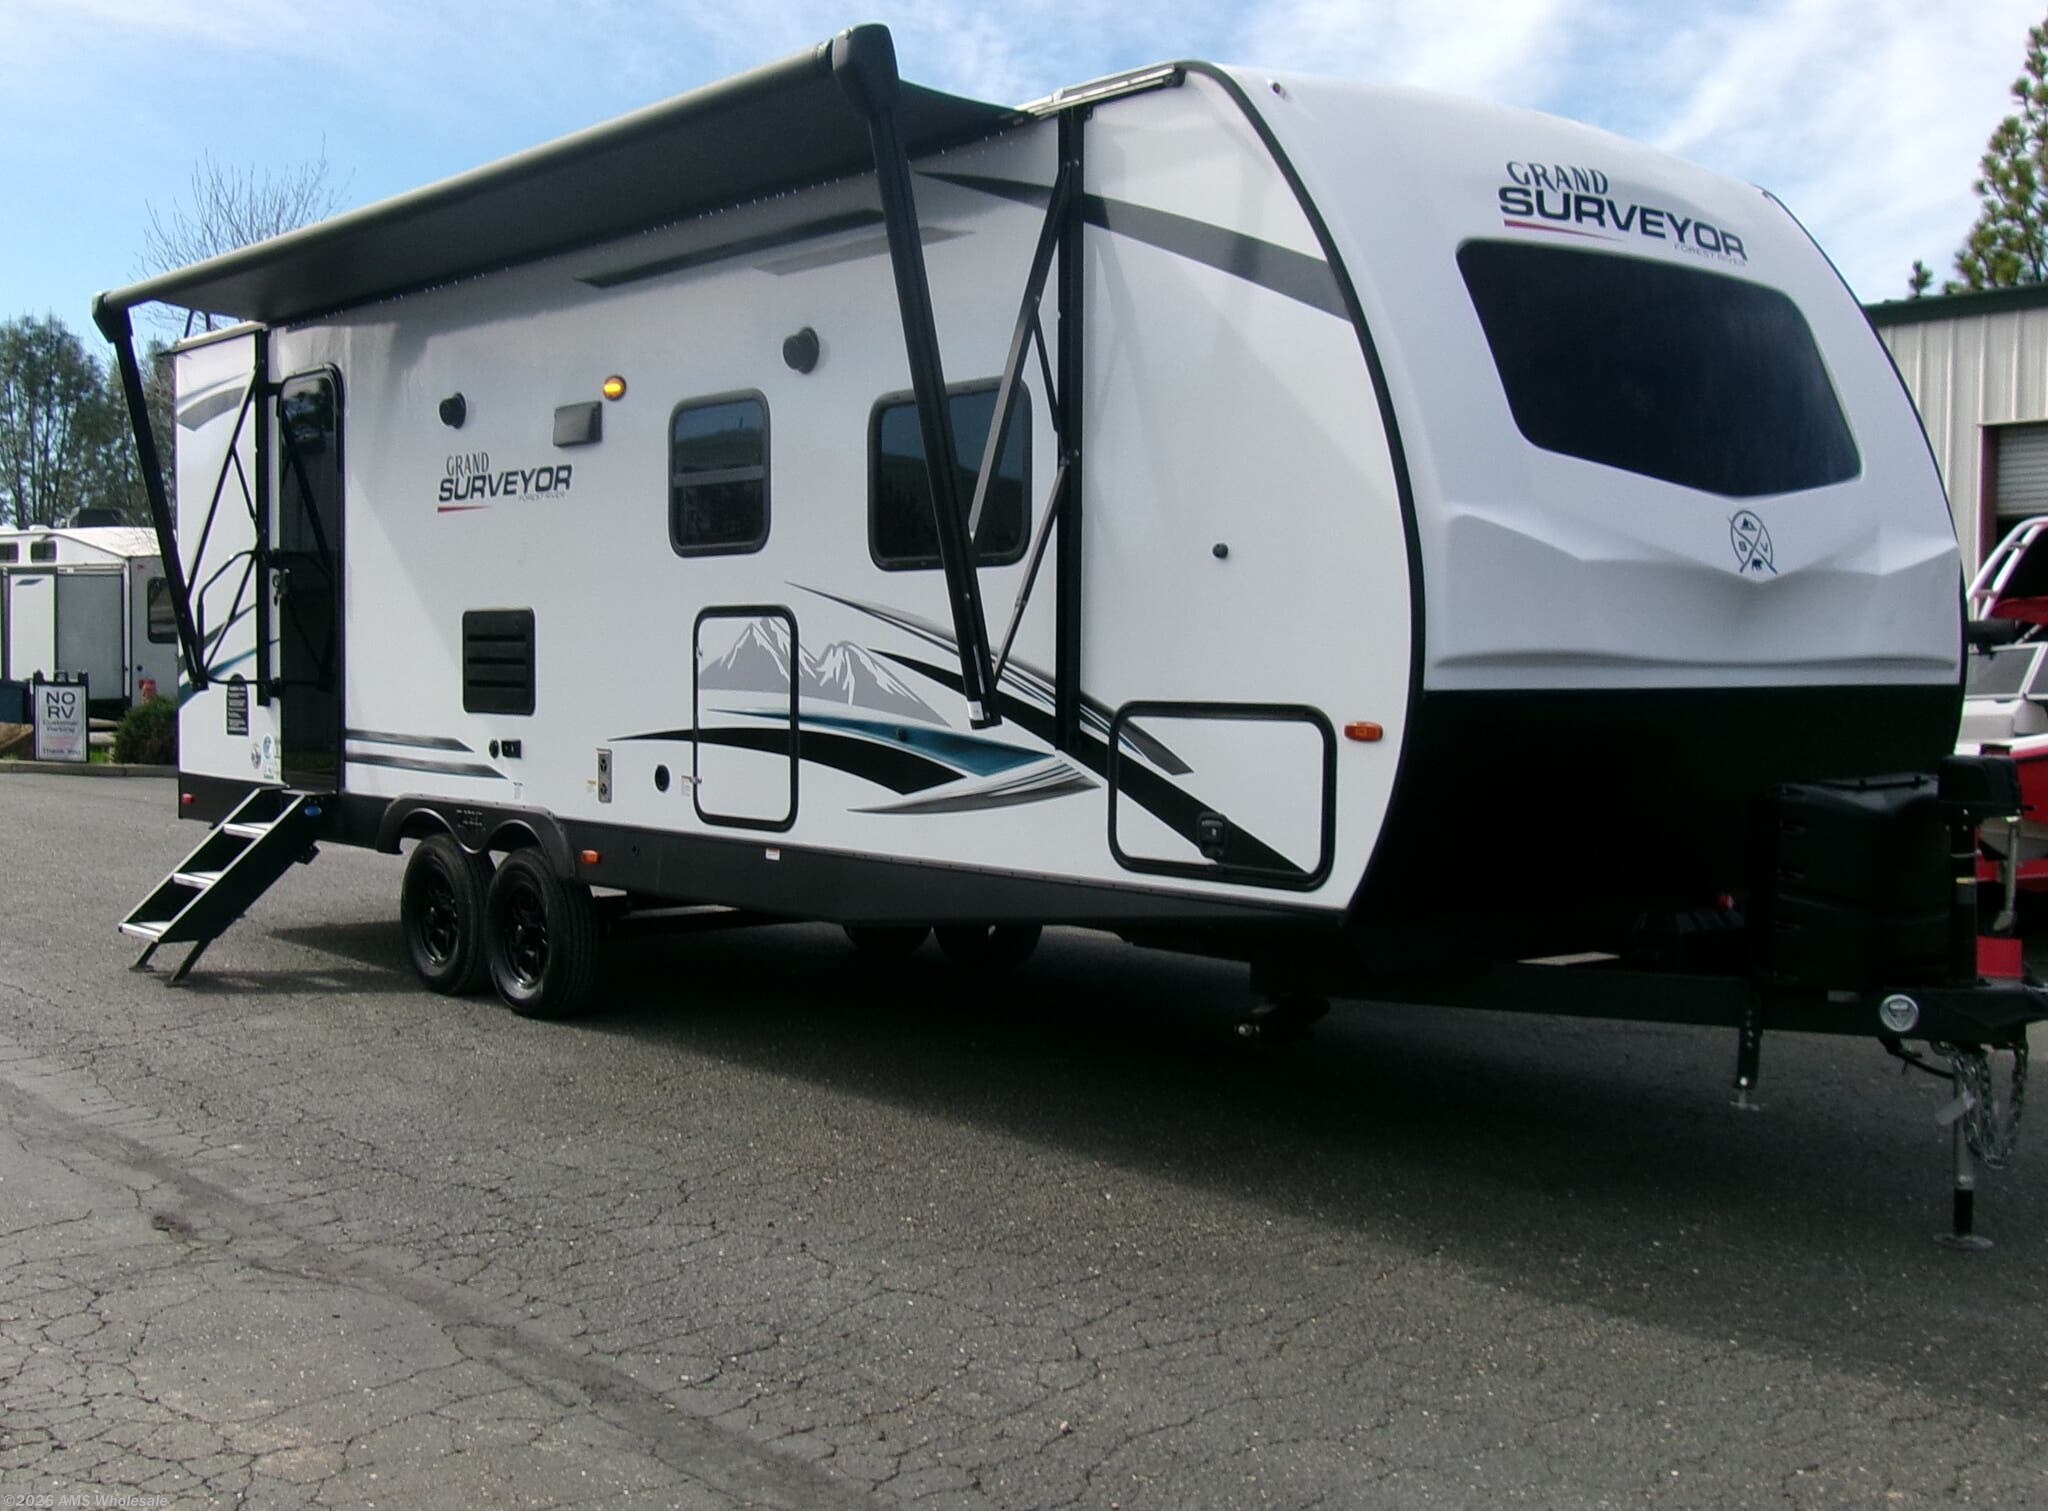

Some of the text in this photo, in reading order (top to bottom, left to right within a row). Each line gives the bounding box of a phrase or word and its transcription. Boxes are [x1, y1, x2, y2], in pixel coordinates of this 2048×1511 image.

[1506, 160, 1609, 195] GRAND
[1498, 186, 1748, 261] SURVEYOR
[446, 451, 490, 477] GRAND
[438, 464, 573, 502] SURVEYOR
[46, 690, 76, 705] NO
[47, 705, 74, 719] RV
